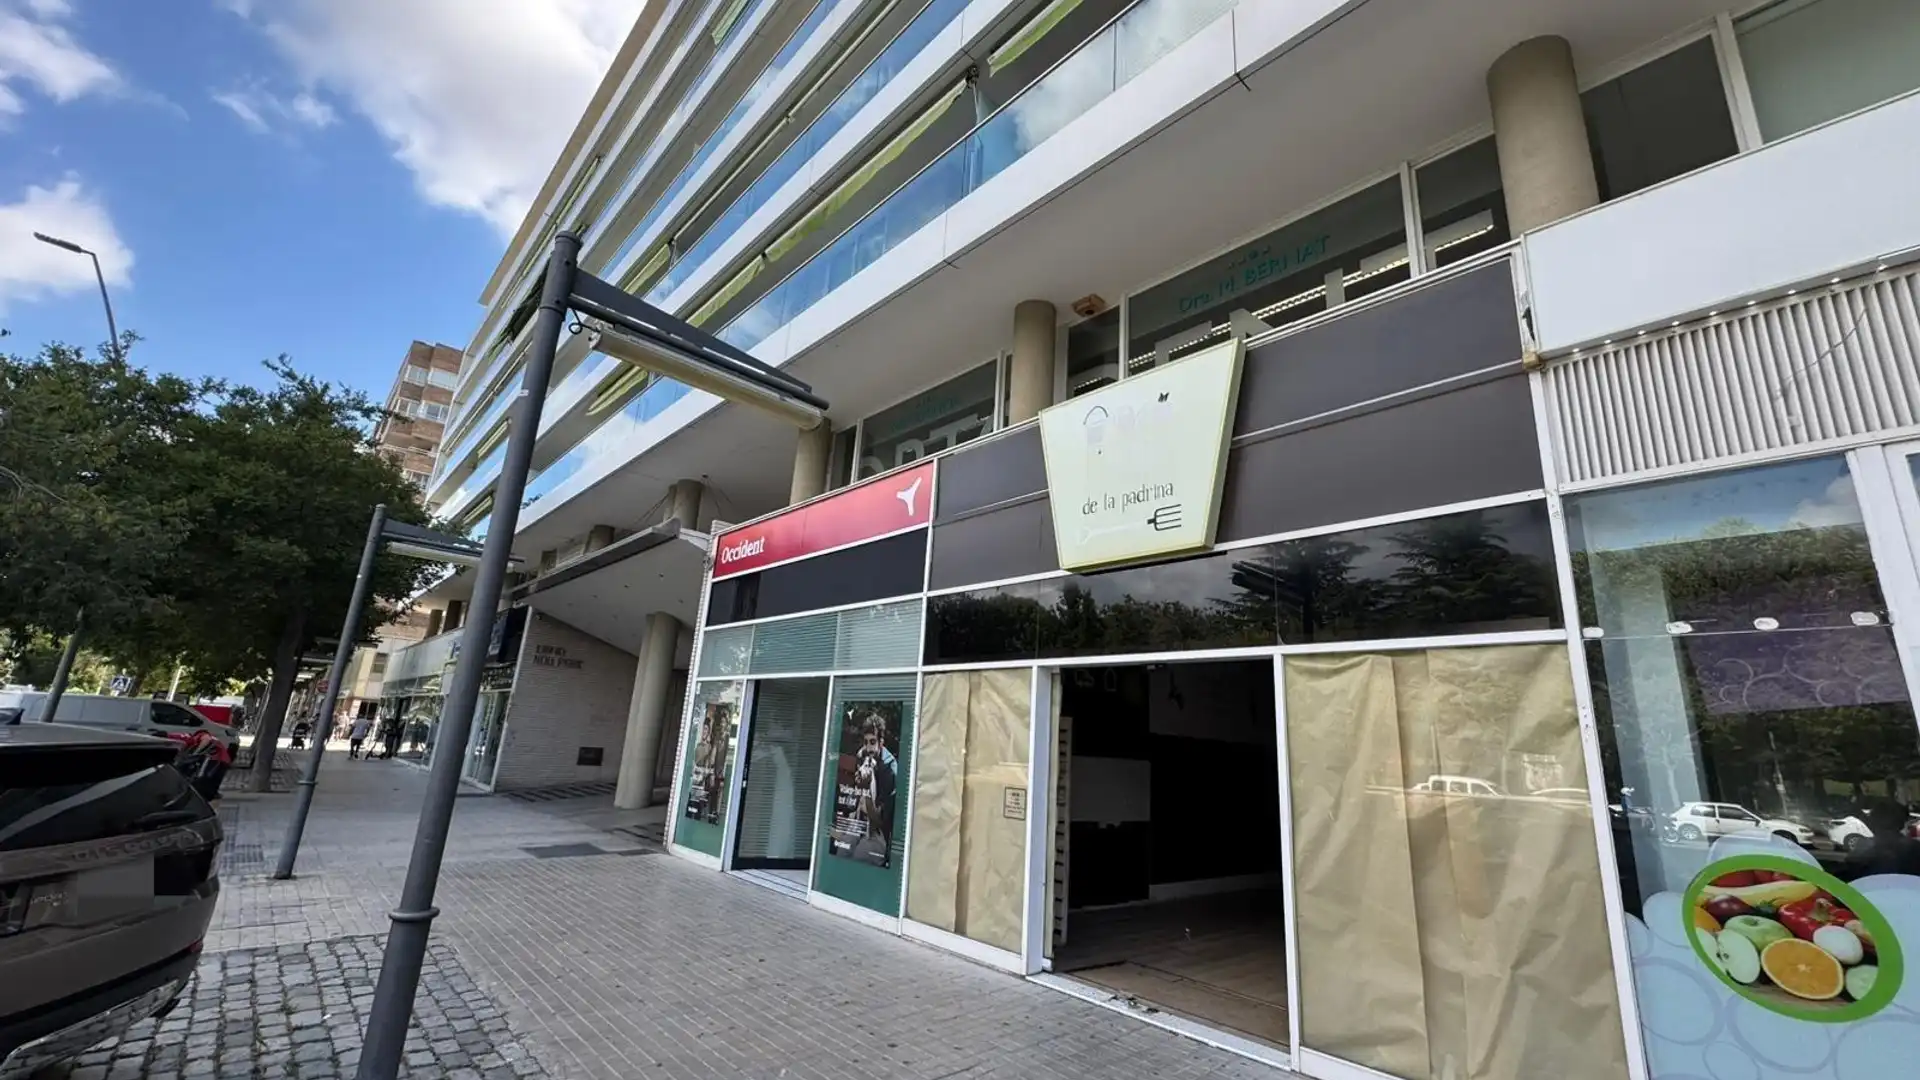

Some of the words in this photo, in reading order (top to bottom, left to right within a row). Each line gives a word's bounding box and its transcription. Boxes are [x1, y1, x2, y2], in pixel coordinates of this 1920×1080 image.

[1082, 496, 1098, 515] de
[1103, 492, 1115, 511] la
[1122, 482, 1174, 513] padrina
[721, 536, 765, 565] Occident
